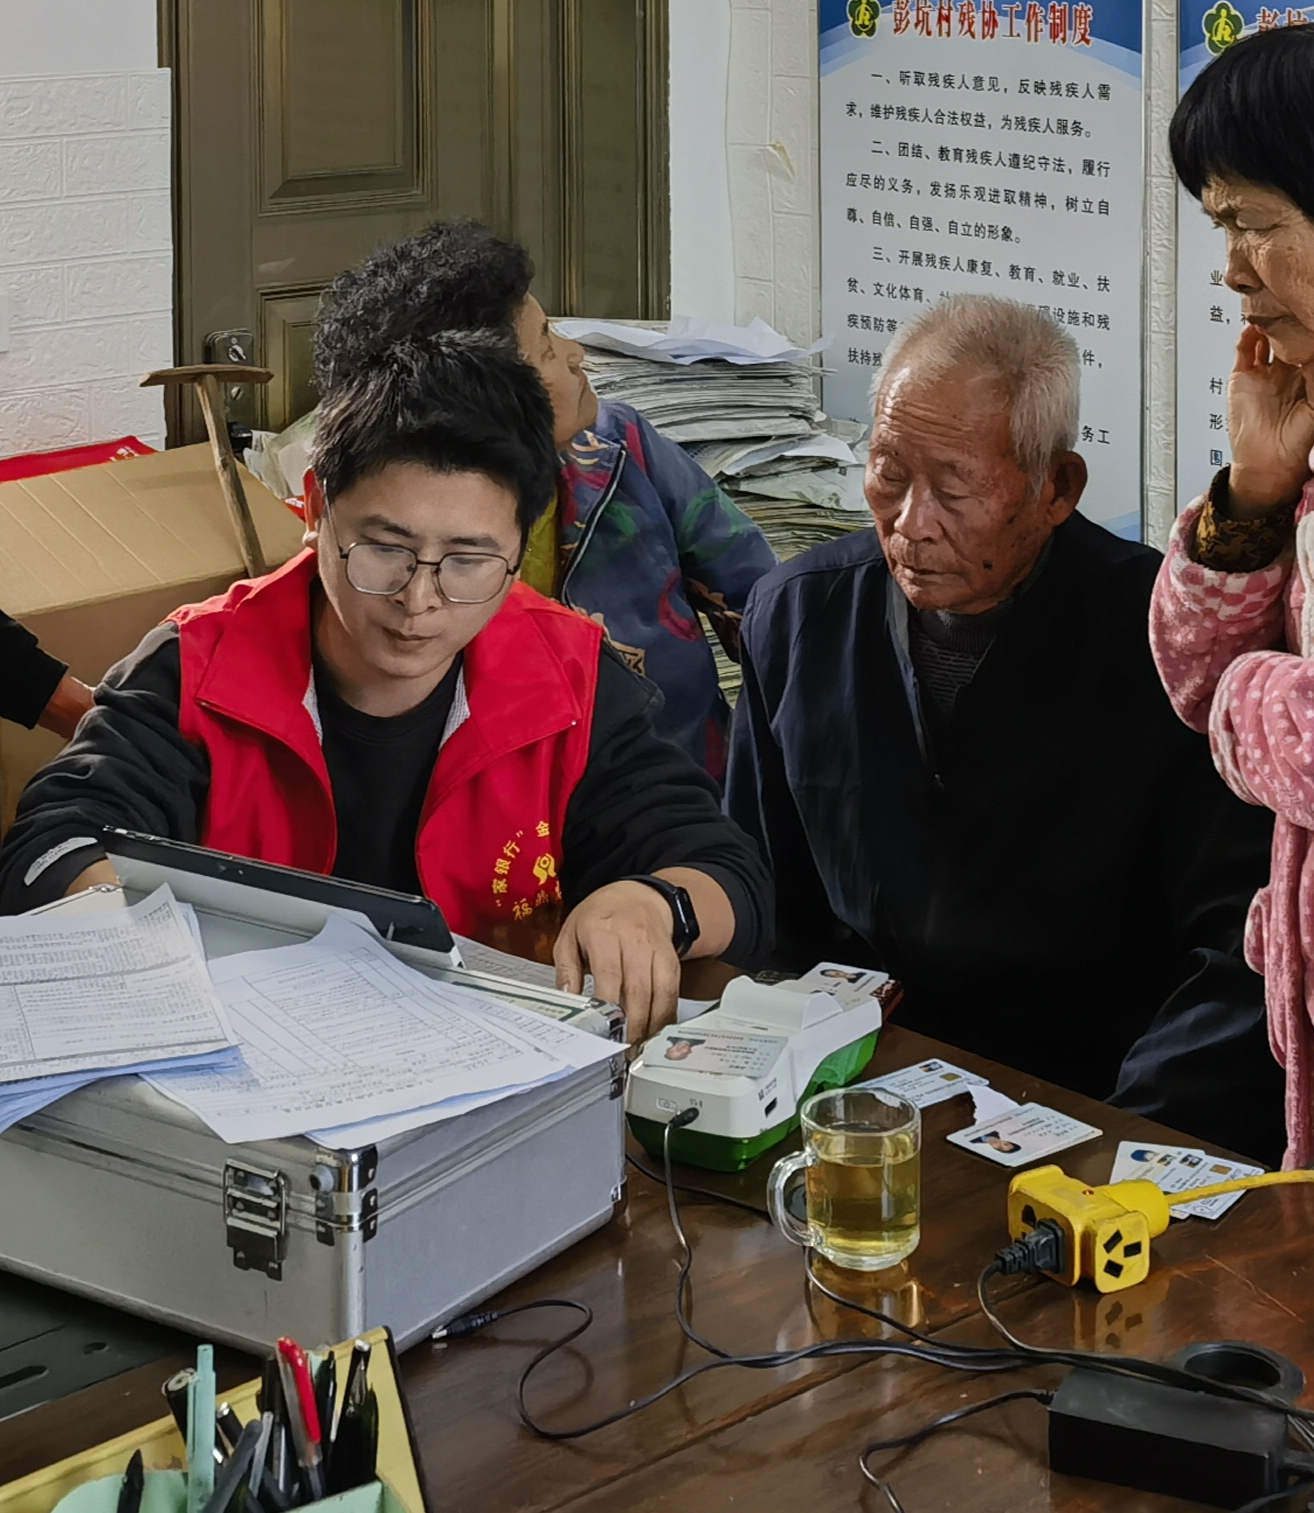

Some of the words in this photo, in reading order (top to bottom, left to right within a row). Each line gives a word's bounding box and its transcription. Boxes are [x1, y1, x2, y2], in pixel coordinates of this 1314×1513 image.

[870, 70, 1112, 102] 一、听取残疾人意见，反映残疾人需
[845, 101, 1092, 138] 求，维护残疾人合法权益，为残疾人服务。
[870, 140, 1112, 178] 二、团结、教育残疾人遵纪守法，履行
[845, 172, 1110, 217] 应尽的义务，发扬乐观进取精神，树立自
[846, 206, 1021, 245] 尊、自信、自强、自立的形象。
[871, 246, 1111, 293] 三、开展残疾人康复、教育、就业、扶
[1209, 269, 1224, 287] 业
[1209, 376, 1224, 395] 村
[1081, 425, 1111, 444] 务工
[535, 820, 550, 838] 金
